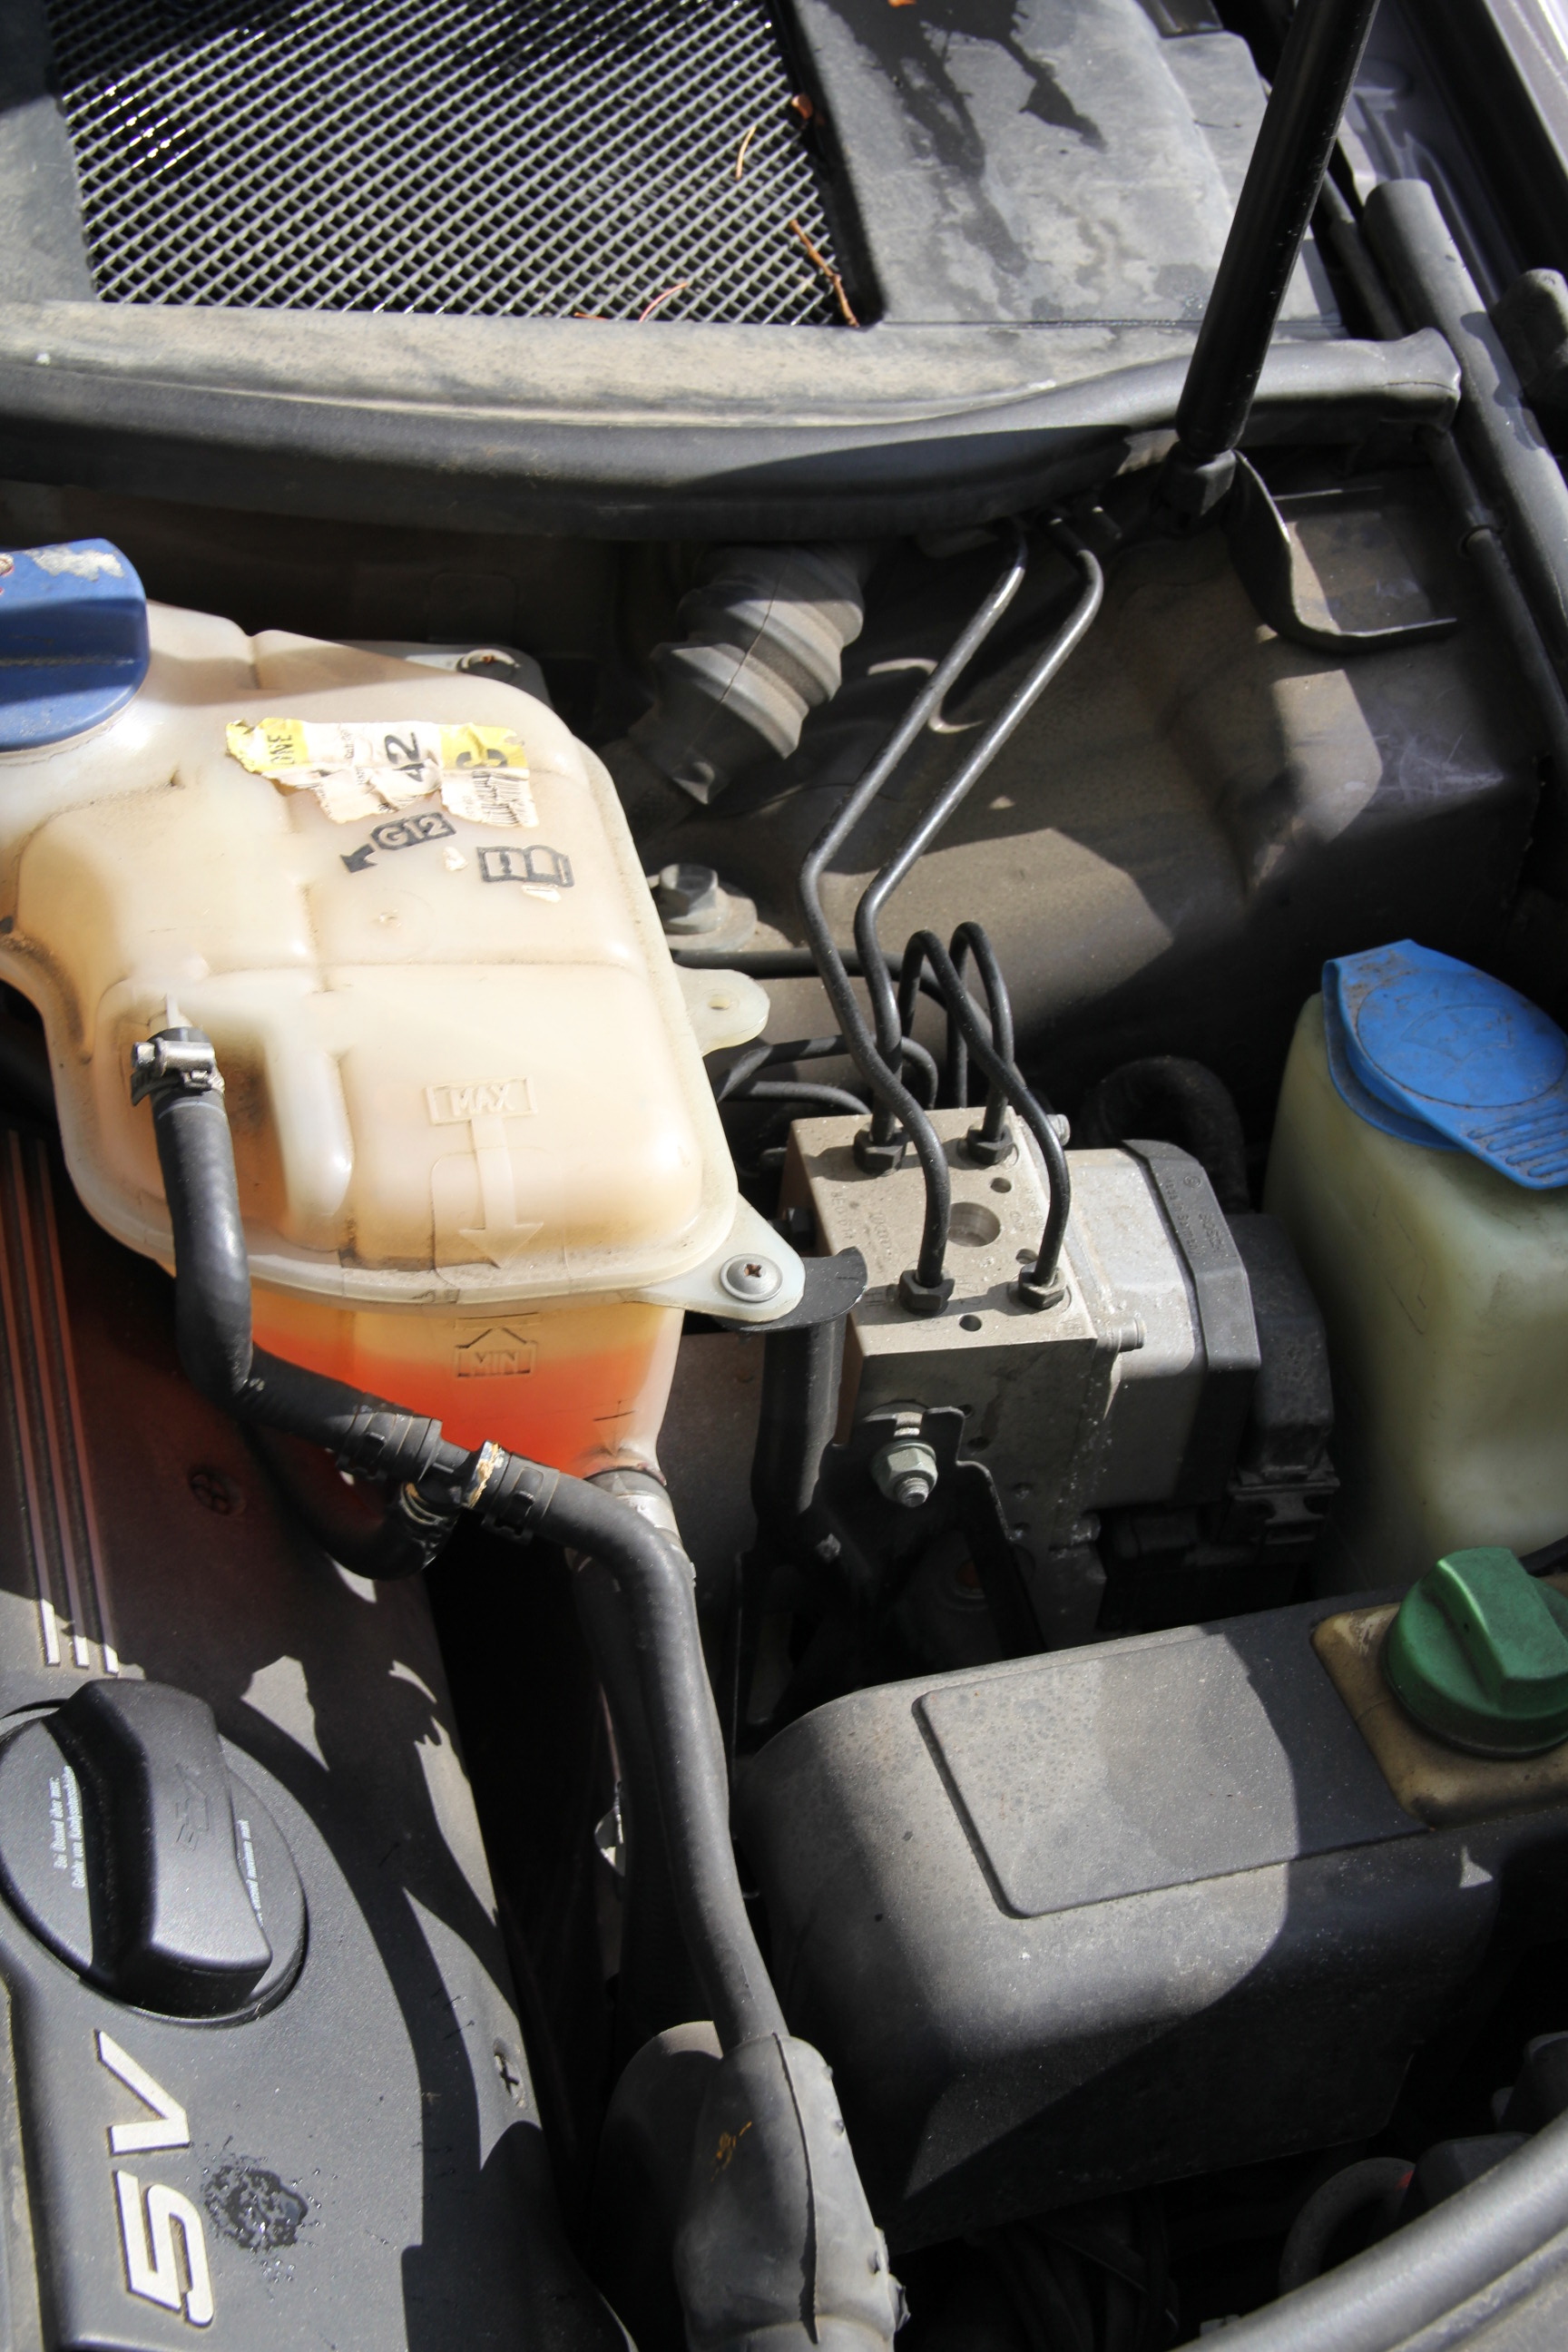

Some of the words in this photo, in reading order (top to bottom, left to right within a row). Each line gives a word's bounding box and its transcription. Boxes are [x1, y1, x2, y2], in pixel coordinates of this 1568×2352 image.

[384, 731, 425, 782] 42
[377, 815, 452, 848] G12
[449, 1083, 516, 1118] MAX
[469, 1350, 520, 1376] MIN
[94, 2029, 215, 2327] 5V
